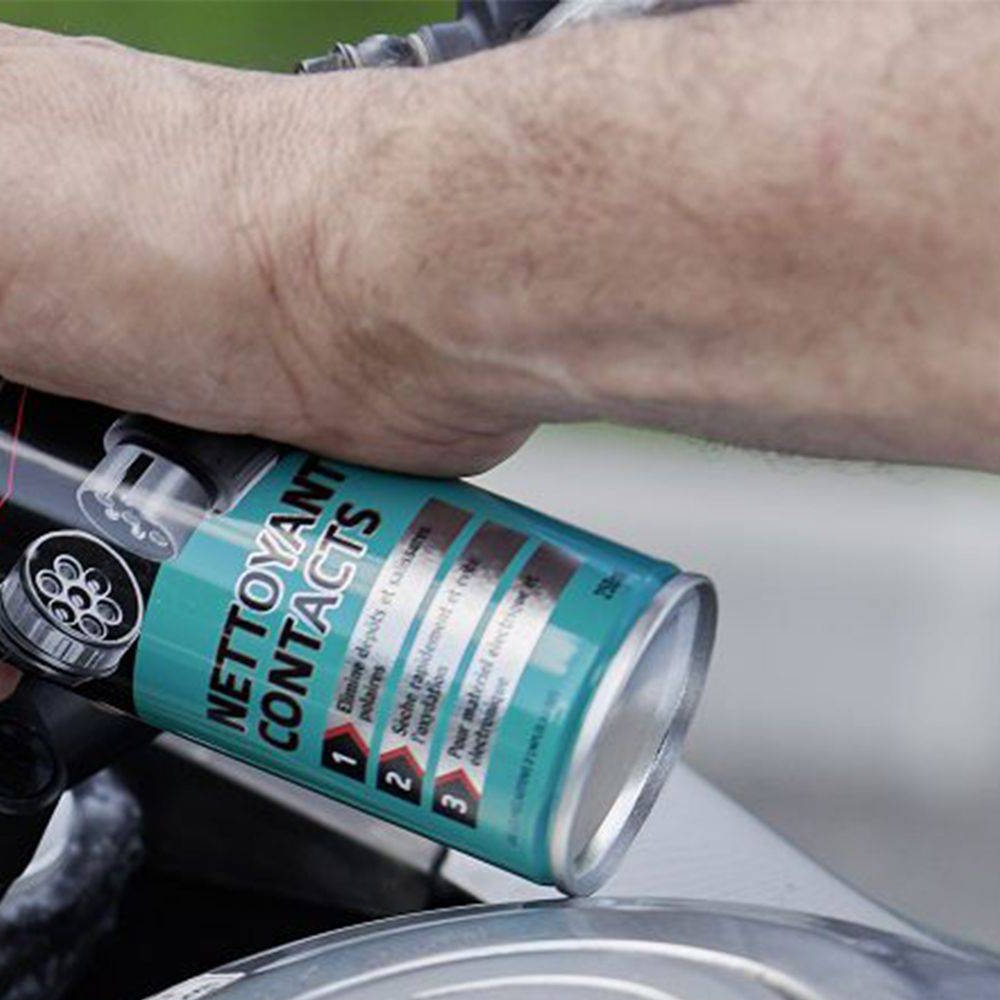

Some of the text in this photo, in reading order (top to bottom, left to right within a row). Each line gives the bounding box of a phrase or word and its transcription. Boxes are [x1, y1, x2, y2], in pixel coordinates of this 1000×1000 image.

[206, 455, 346, 733] NETTOYANT
[258, 502, 381, 752] CONTACTS
[331, 752, 357, 766] 1
[385, 772, 411, 791] 2
[441, 794, 468, 815] 3
